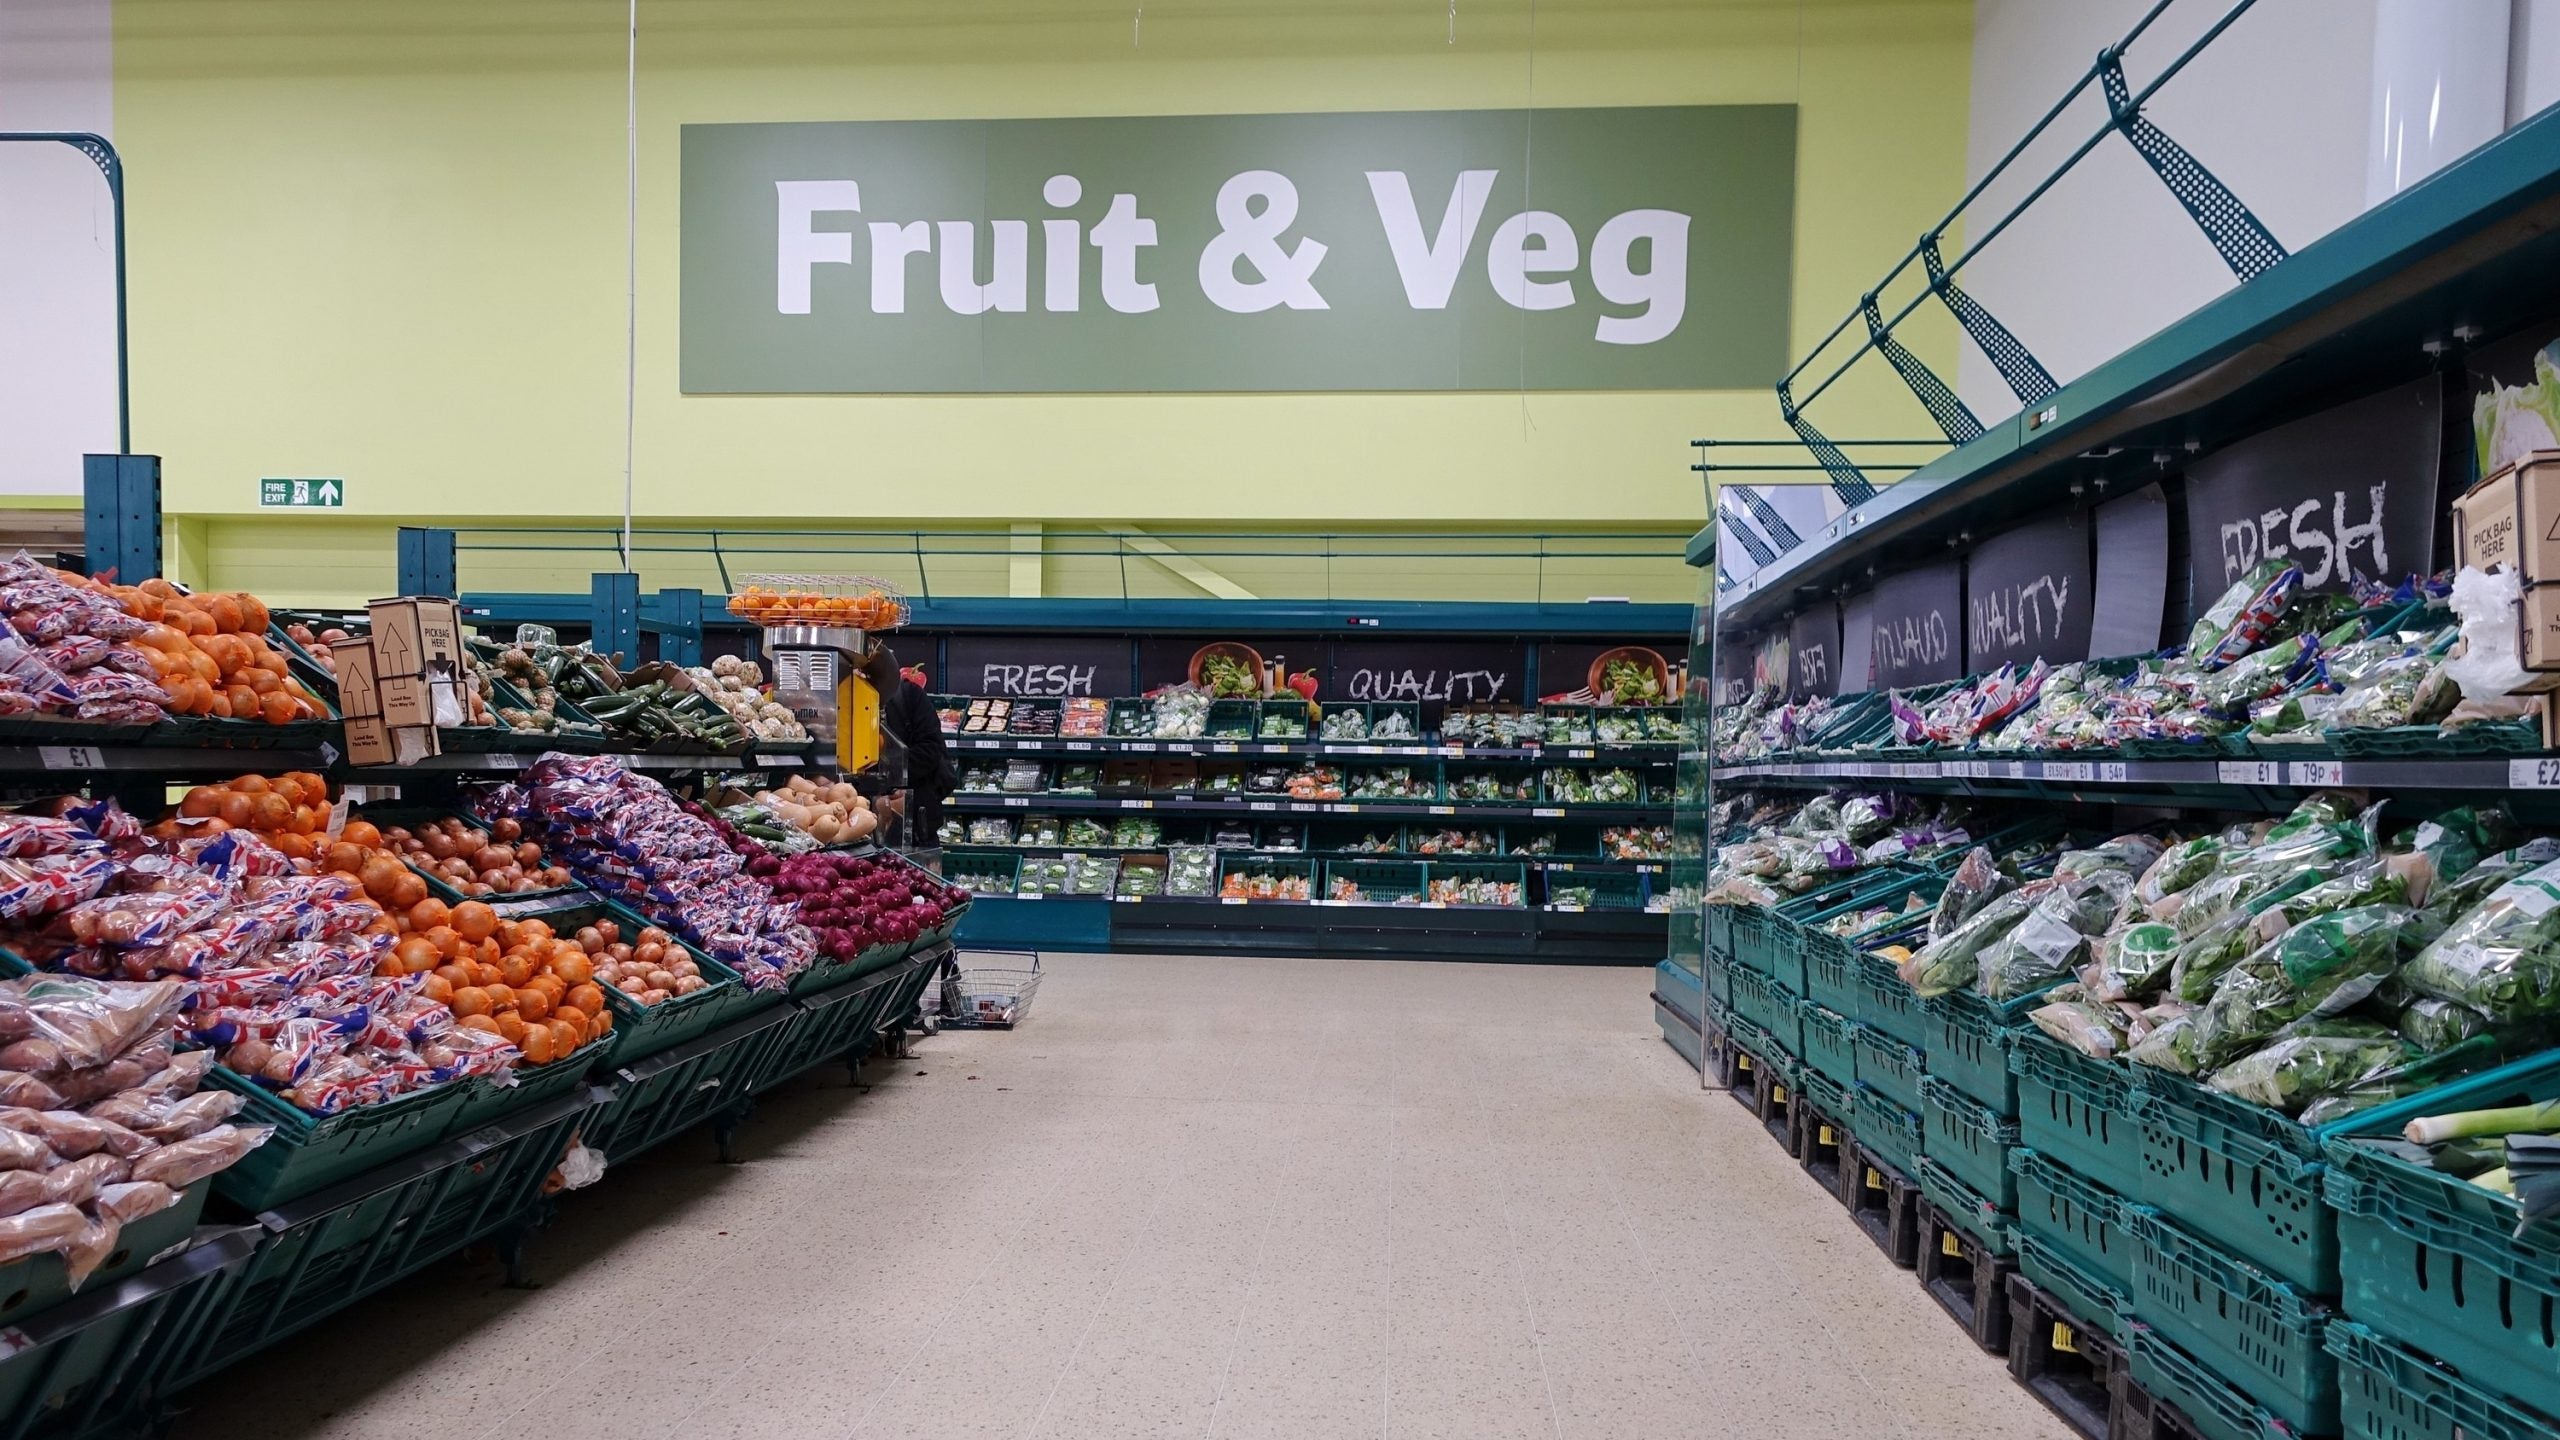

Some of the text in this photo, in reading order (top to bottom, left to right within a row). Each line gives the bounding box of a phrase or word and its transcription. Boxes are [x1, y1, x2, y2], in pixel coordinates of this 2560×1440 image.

[775, 169, 1691, 346] Fruit & Veg
[265, 483, 286, 492] FIRE
[265, 494, 286, 502] EXIT
[2221, 480, 2388, 590] FRESH
[2474, 516, 2512, 549] PICK BAG
[2481, 537, 2505, 561] HERE
[1972, 575, 2068, 655] QUALITY
[432, 638, 447, 648] HERE
[983, 664, 1097, 695] FRESH
[1349, 668, 1506, 701] QUALITY
[69, 747, 91, 767] £1
[2080, 764, 2088, 779] £1
[2109, 765, 2123, 780] 54p
[2258, 764, 2270, 783] £1
[2303, 763, 2325, 783] 79p
[2537, 760, 2560, 786] £2
